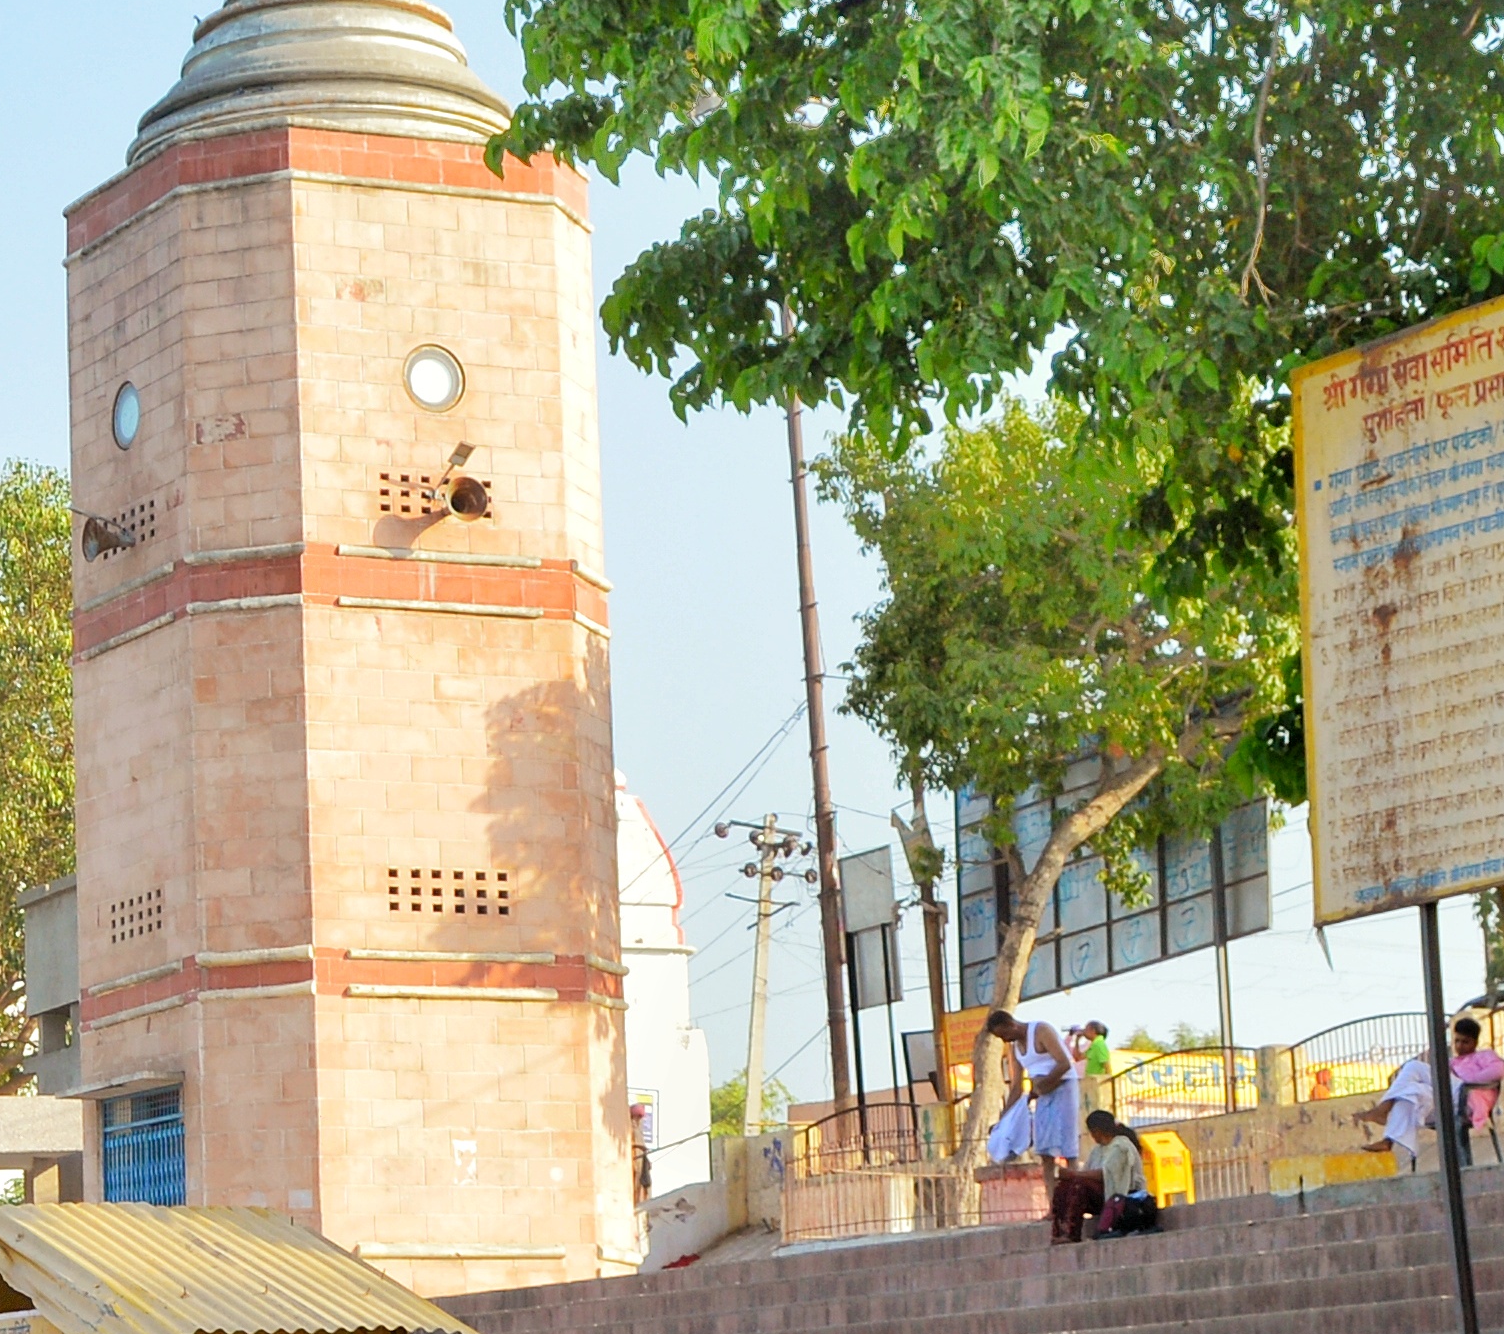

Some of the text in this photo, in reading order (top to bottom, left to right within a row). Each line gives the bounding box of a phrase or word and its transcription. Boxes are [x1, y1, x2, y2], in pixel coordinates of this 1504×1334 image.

[1323, 373, 1347, 412] श्री
[1391, 351, 1428, 389] सेवा
[1429, 326, 1494, 372] समिति
